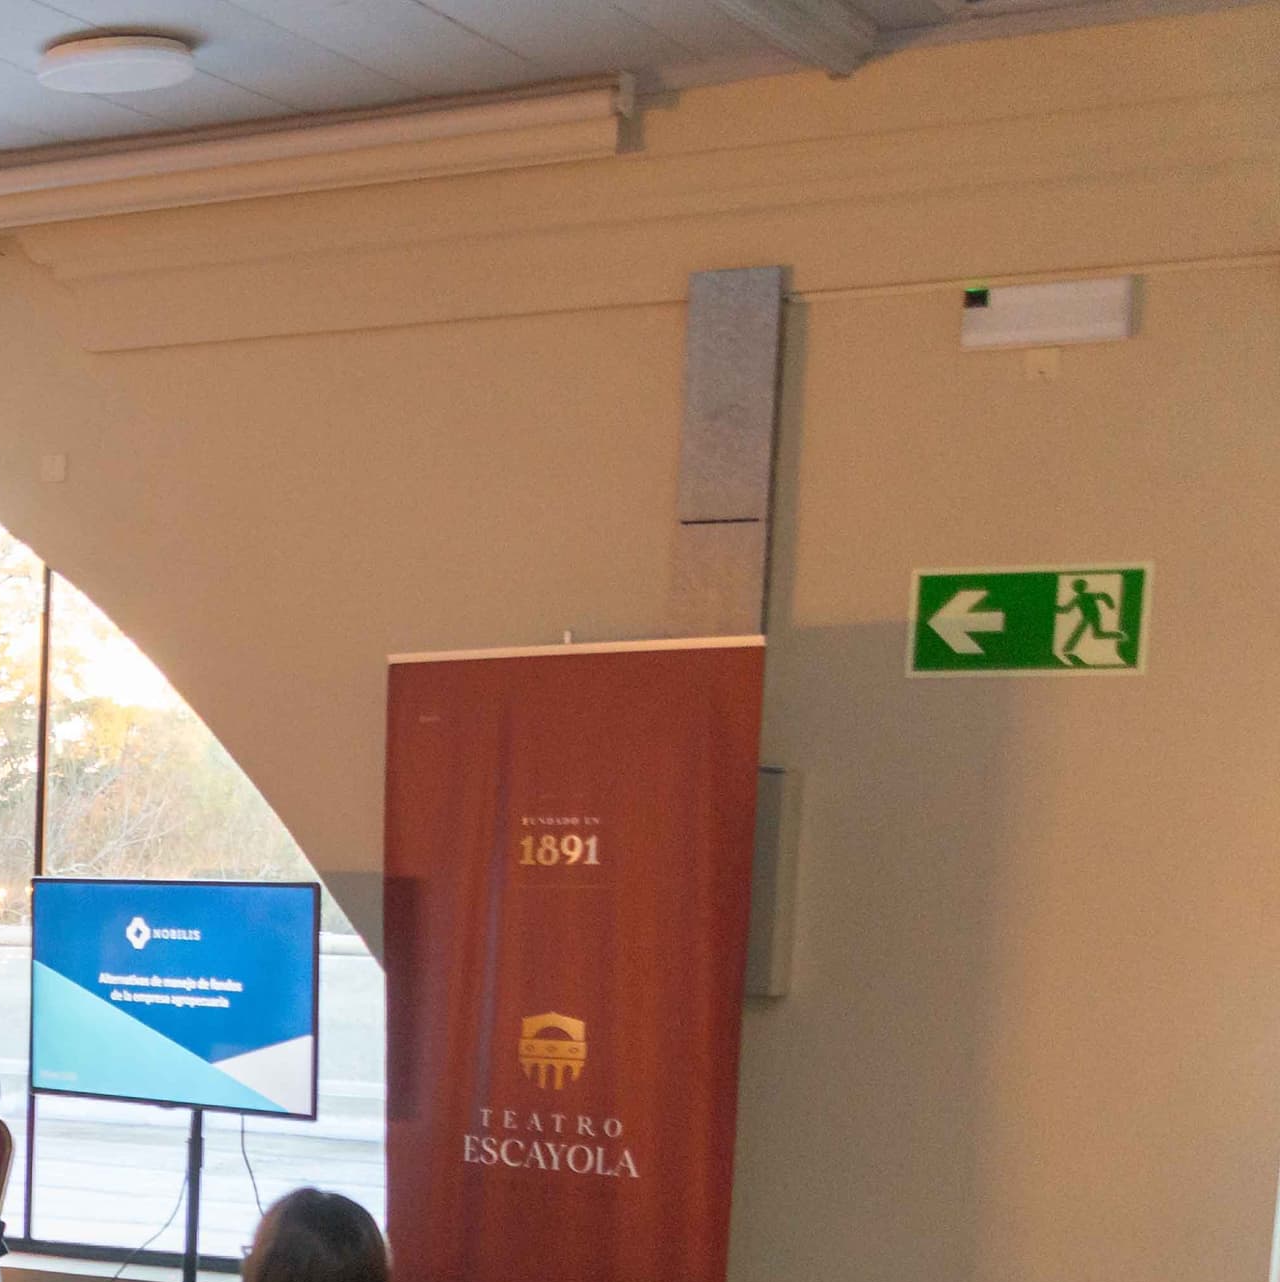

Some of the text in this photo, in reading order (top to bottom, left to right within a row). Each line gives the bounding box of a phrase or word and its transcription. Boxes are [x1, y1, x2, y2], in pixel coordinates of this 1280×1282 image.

[520, 834, 600, 865] 1891
[153, 928, 201, 941] NOBILIS
[480, 1108, 623, 1137] TEATRO
[464, 1134, 640, 1178] ESCAYOLA
